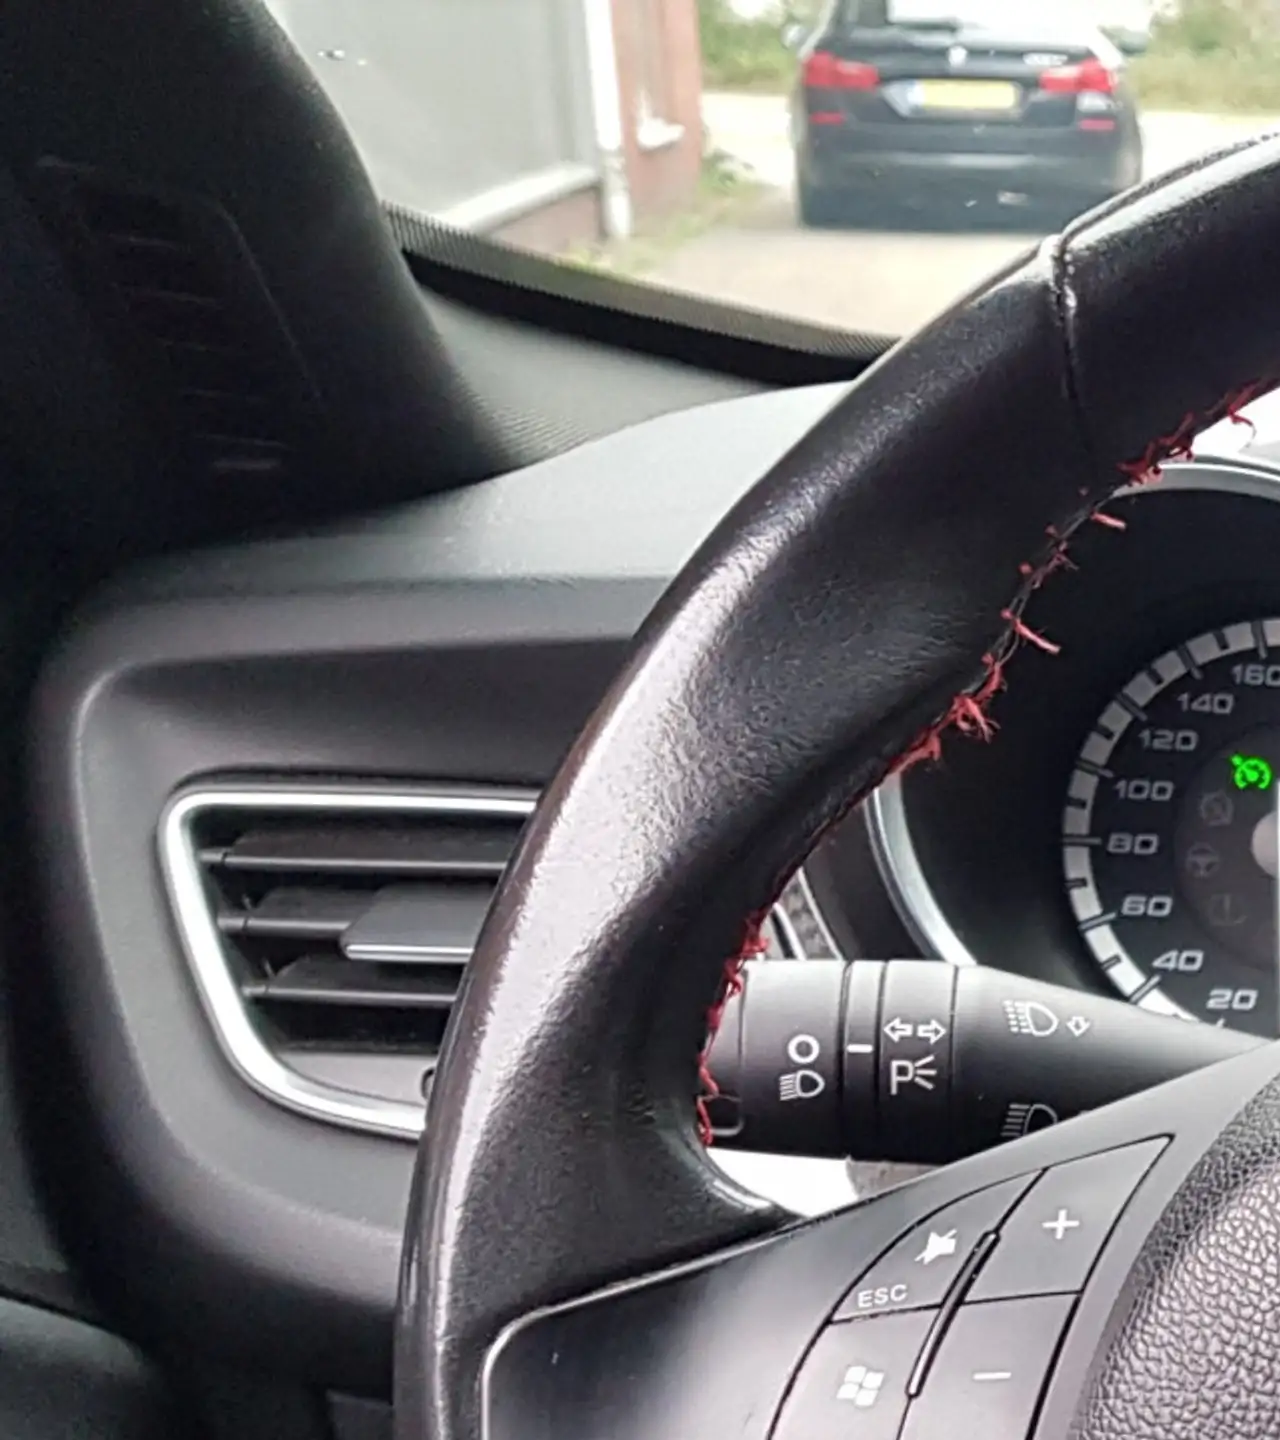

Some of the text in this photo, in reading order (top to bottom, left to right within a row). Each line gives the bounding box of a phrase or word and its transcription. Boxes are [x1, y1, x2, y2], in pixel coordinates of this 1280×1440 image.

[1176, 693, 1235, 714] 140
[1138, 729, 1199, 751] 120
[1112, 781, 1174, 801] 100
[1106, 834, 1159, 854] 80
[1121, 897, 1174, 916] 60
[1151, 949, 1204, 972] 40
[1206, 988, 1259, 1011] 20
[857, 1284, 909, 1309] ESC
